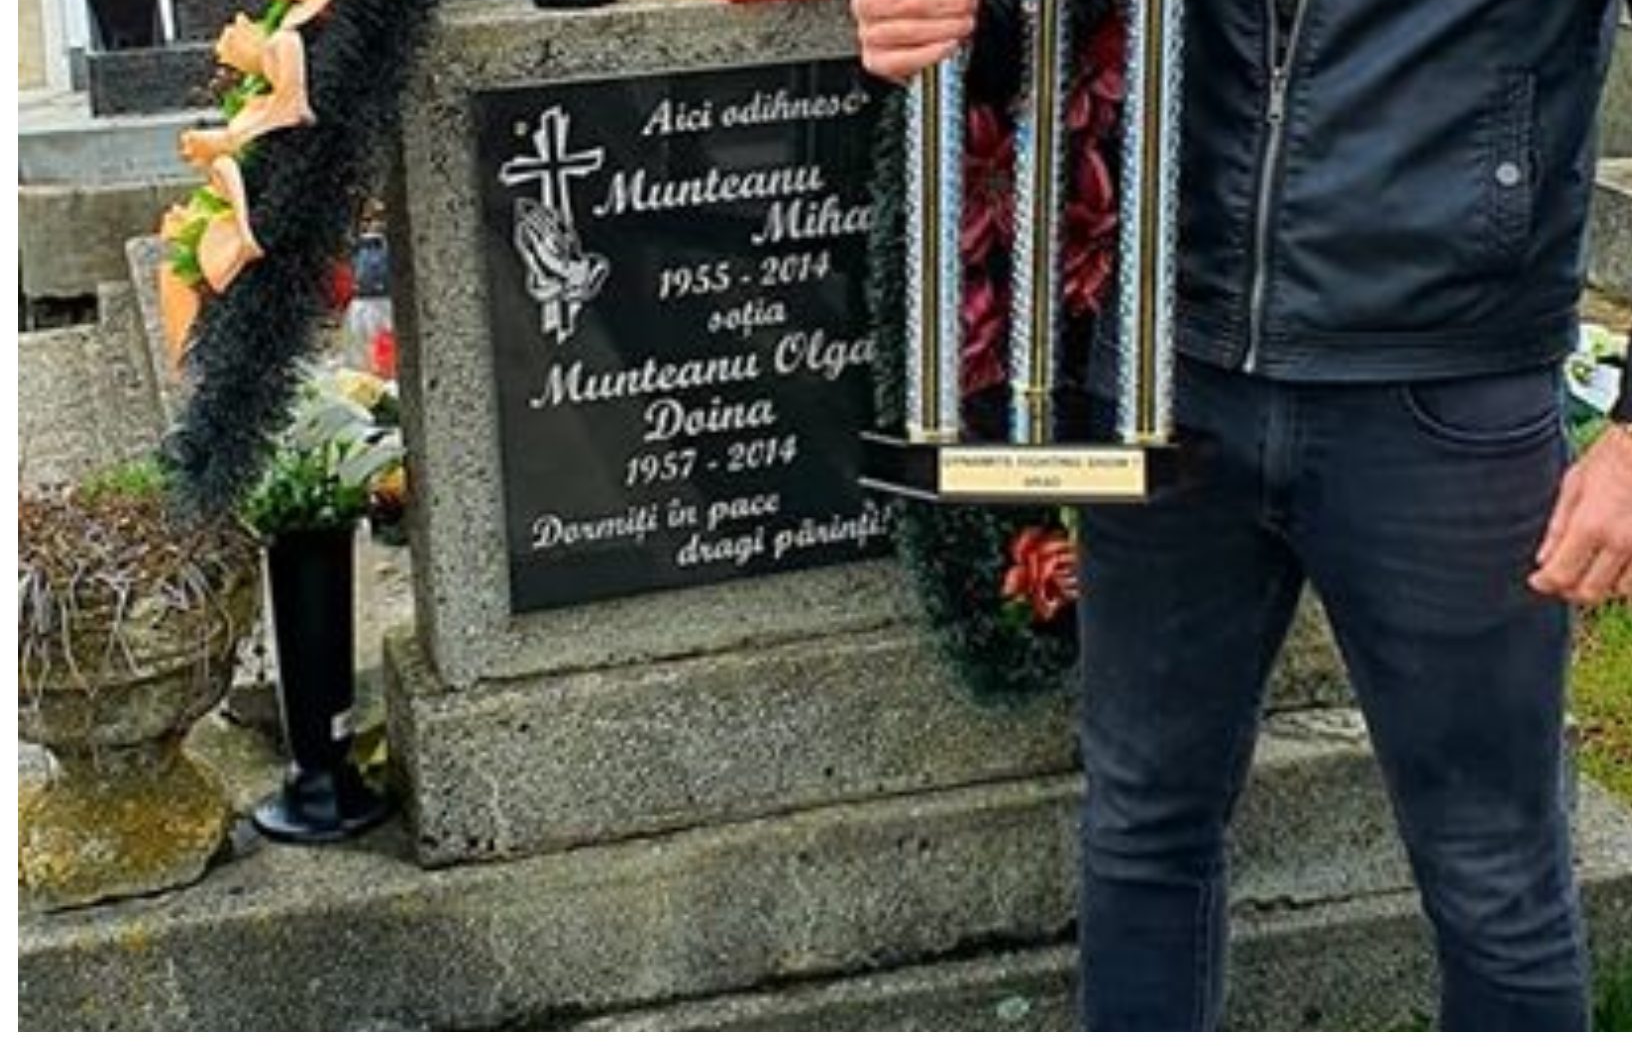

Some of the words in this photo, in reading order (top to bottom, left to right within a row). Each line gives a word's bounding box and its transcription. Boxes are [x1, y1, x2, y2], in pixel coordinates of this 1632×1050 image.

[642, 97, 713, 136] Aici
[592, 163, 827, 216] Munteanu
[751, 194, 873, 244] Miha
[658, 261, 731, 299] 1955
[760, 250, 830, 289] 2014
[530, 350, 761, 409] Munteanu
[773, 329, 878, 382] Olga
[643, 397, 777, 443] Doina
[625, 448, 695, 487] 1957
[726, 435, 799, 474] 2014
[667, 495, 698, 529] în
[707, 492, 781, 530] pace
[676, 528, 766, 568] dragi
